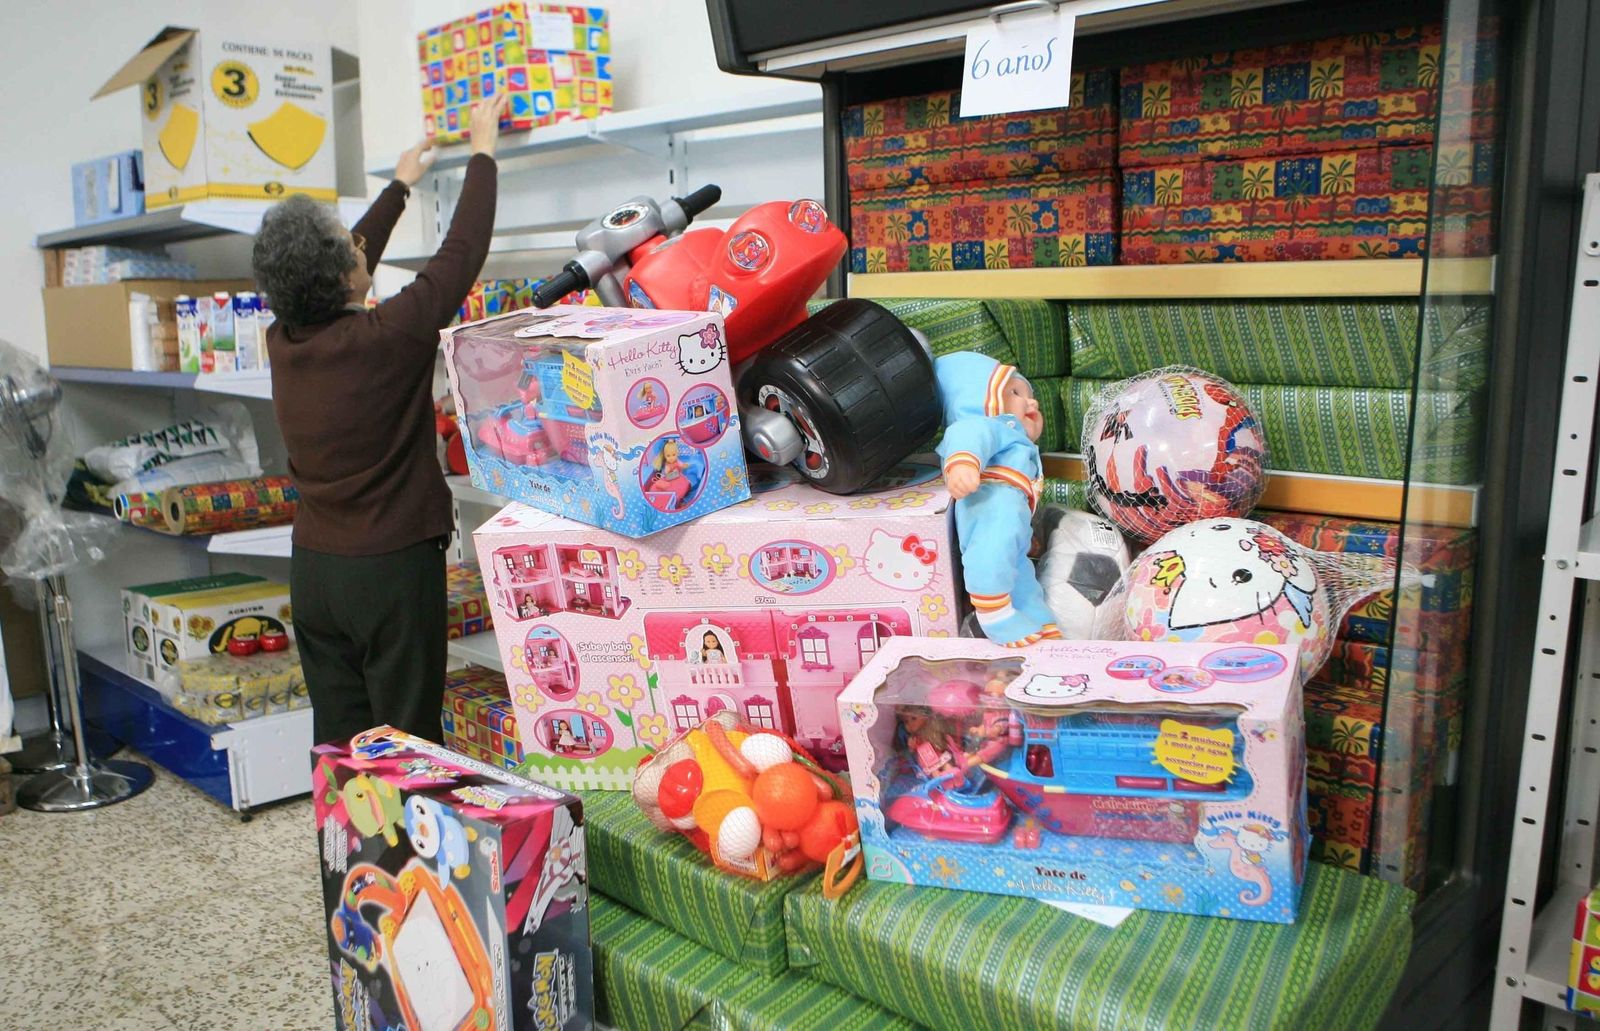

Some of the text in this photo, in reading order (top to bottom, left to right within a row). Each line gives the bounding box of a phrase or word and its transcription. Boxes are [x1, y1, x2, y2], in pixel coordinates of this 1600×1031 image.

[971, 36, 1059, 80] 6 años
[222, 68, 246, 97] 3
[607, 340, 678, 370] Hello Kitty
[1206, 809, 1281, 829] Hello Kitty
[1034, 865, 1087, 881] Yate de
